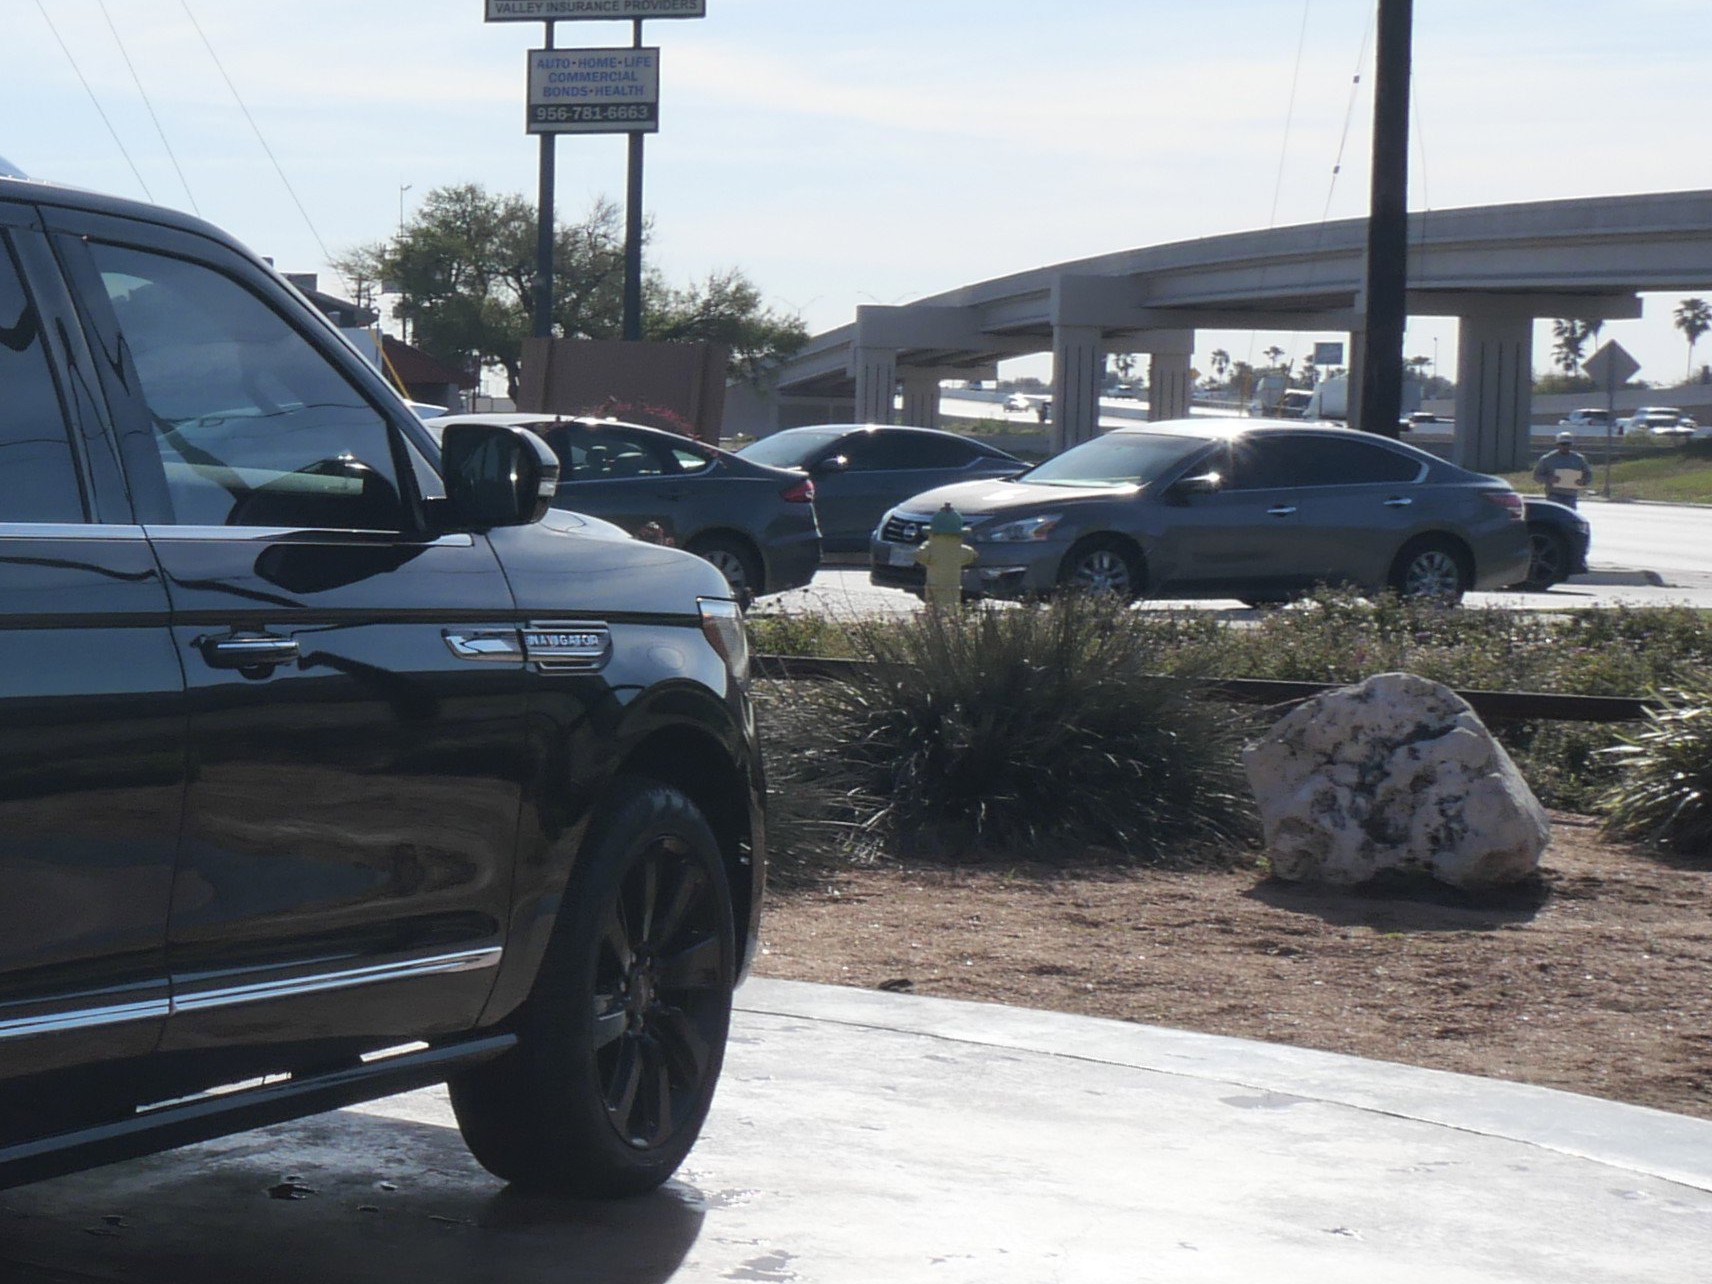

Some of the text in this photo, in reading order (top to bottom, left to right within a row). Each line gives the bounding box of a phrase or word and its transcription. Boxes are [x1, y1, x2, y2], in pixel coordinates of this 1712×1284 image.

[495, 2, 543, 13] VALLEY
[546, 0, 619, 12] INSURANCE
[537, 57, 652, 69] AUTO HOME LIFE
[548, 71, 638, 83] COMMERCIAL
[543, 85, 644, 97] BONDS HEALTH
[527, 634, 599, 646] NAVIGATOR
